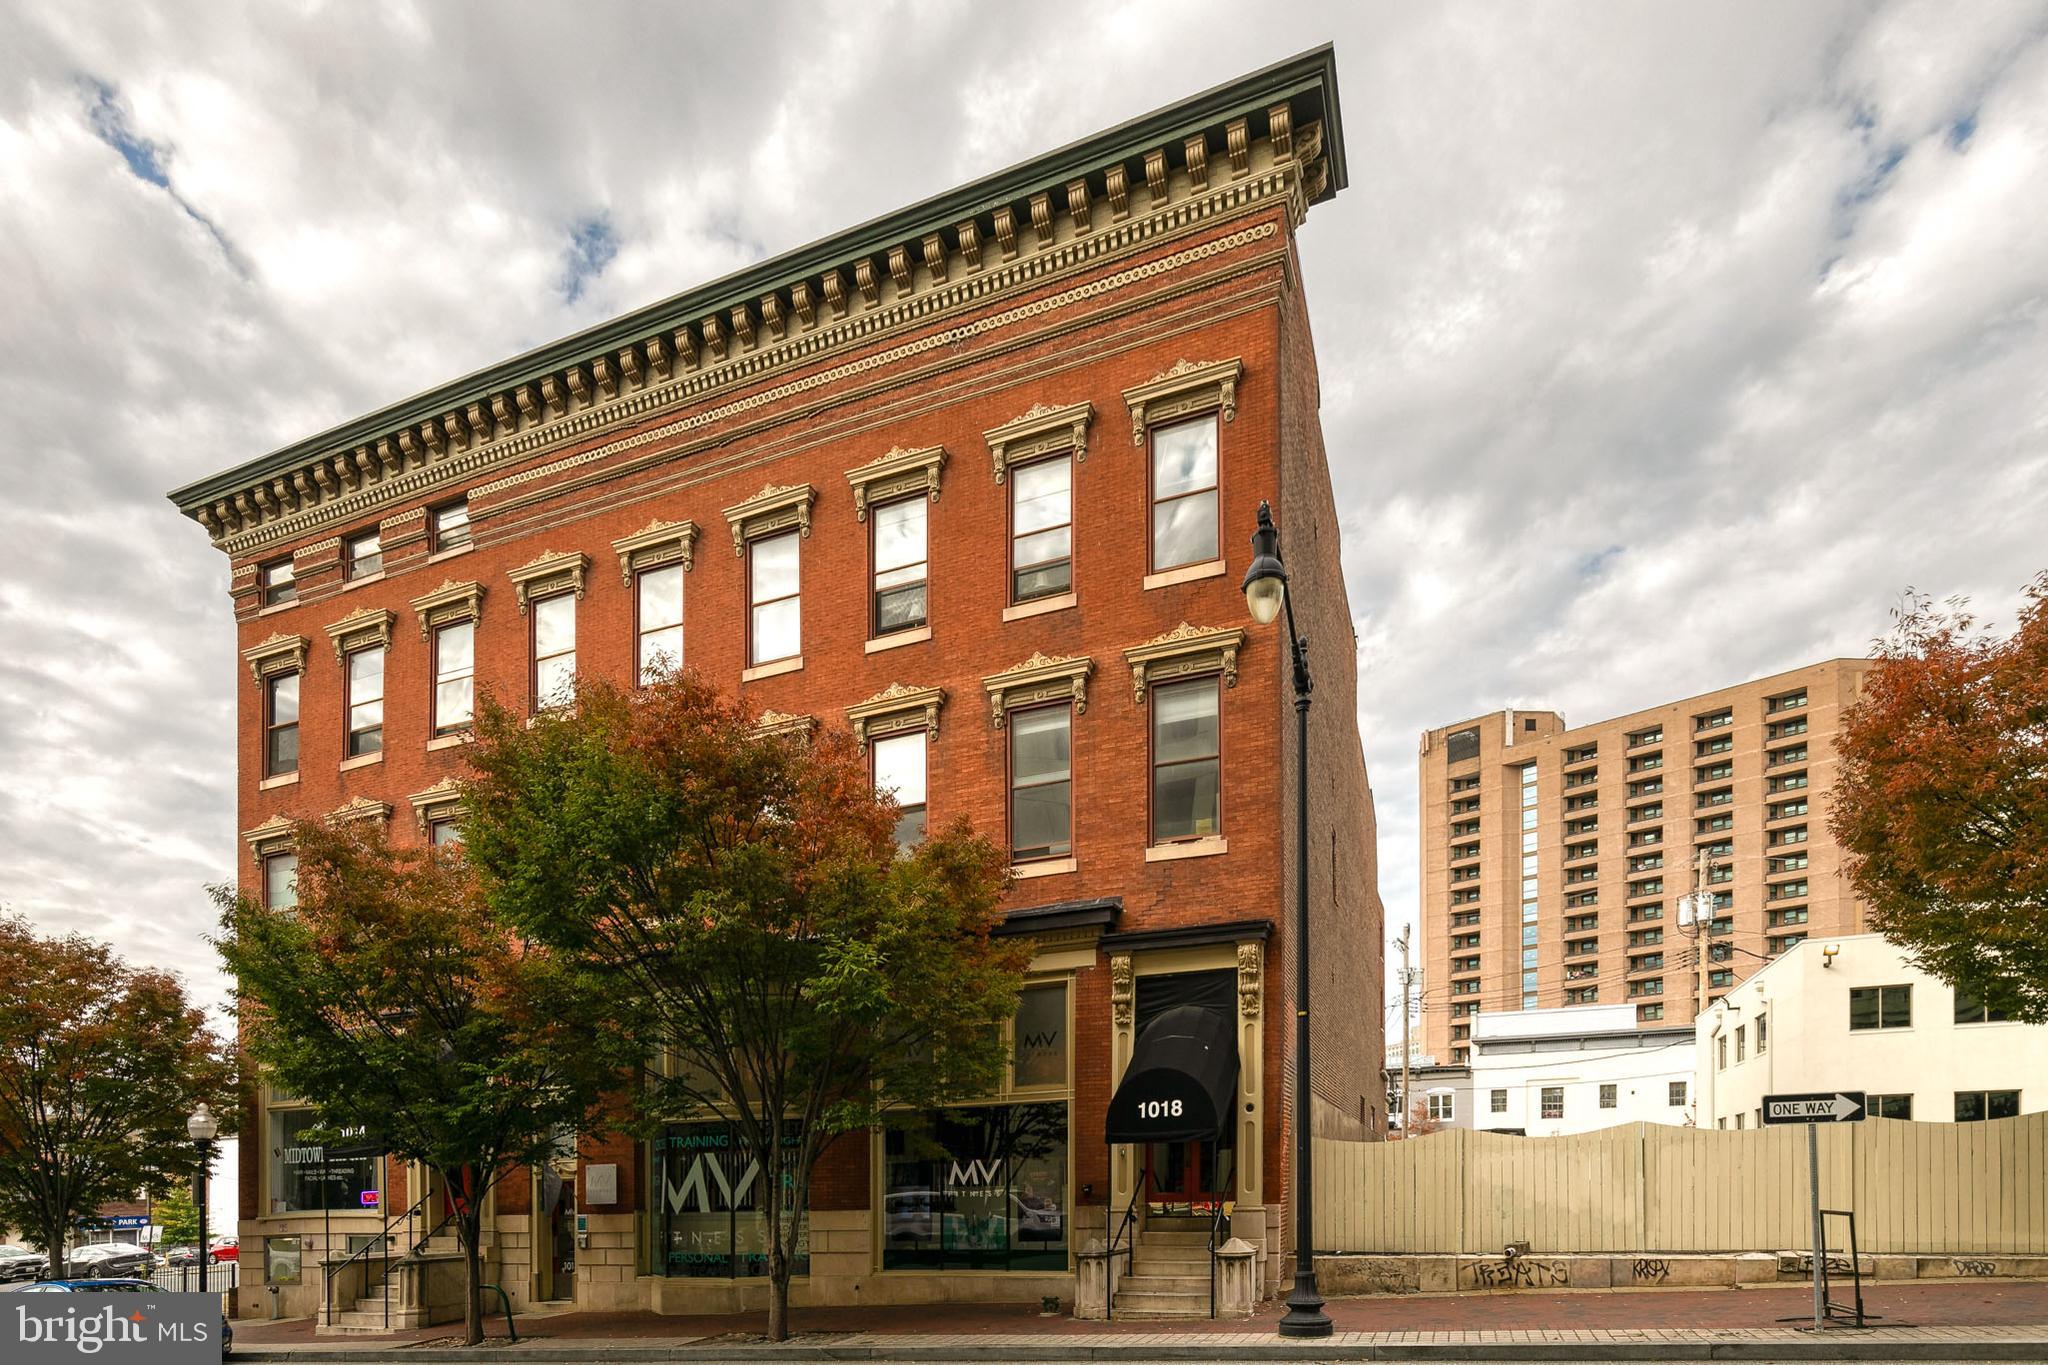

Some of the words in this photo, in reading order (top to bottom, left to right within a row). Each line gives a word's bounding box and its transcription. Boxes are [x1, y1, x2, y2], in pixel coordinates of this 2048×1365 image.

[1024, 1031, 1057, 1048] MV
[1138, 1100, 1183, 1118] 1018
[1773, 1103, 1800, 1115] ONE
[1805, 1102, 1834, 1114] WAY
[670, 1136, 729, 1148] TRAINING
[949, 1159, 1001, 1185] MV
[661, 1152, 760, 1215] MV
[668, 1253, 729, 1264] PERSONAL
